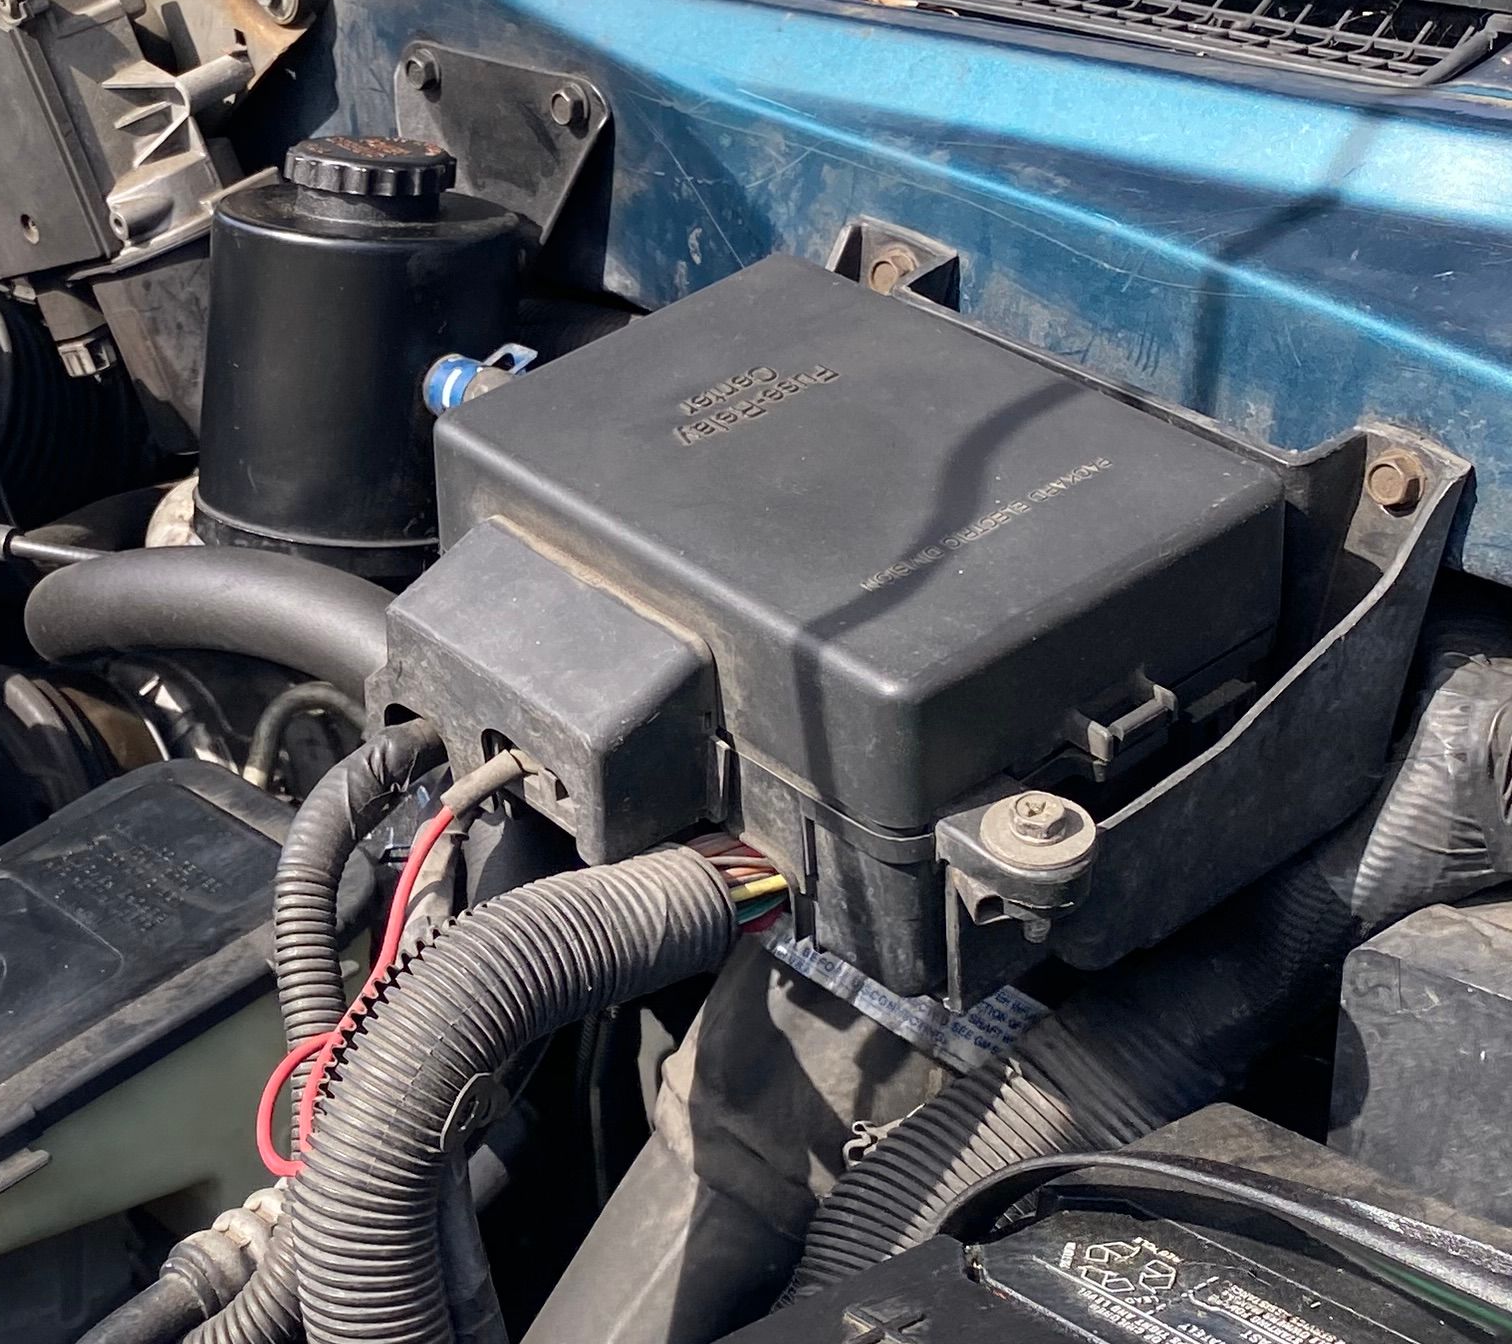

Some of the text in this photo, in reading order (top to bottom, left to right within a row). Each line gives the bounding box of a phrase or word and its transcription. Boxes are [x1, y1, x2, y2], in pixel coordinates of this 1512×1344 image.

[671, 362, 839, 448] Fuse-Relay
[676, 364, 779, 417] Center
[857, 452, 1114, 596] PACKARD ELECTRIC DIVISION
[1123, 1295, 1159, 1305] LEAD
